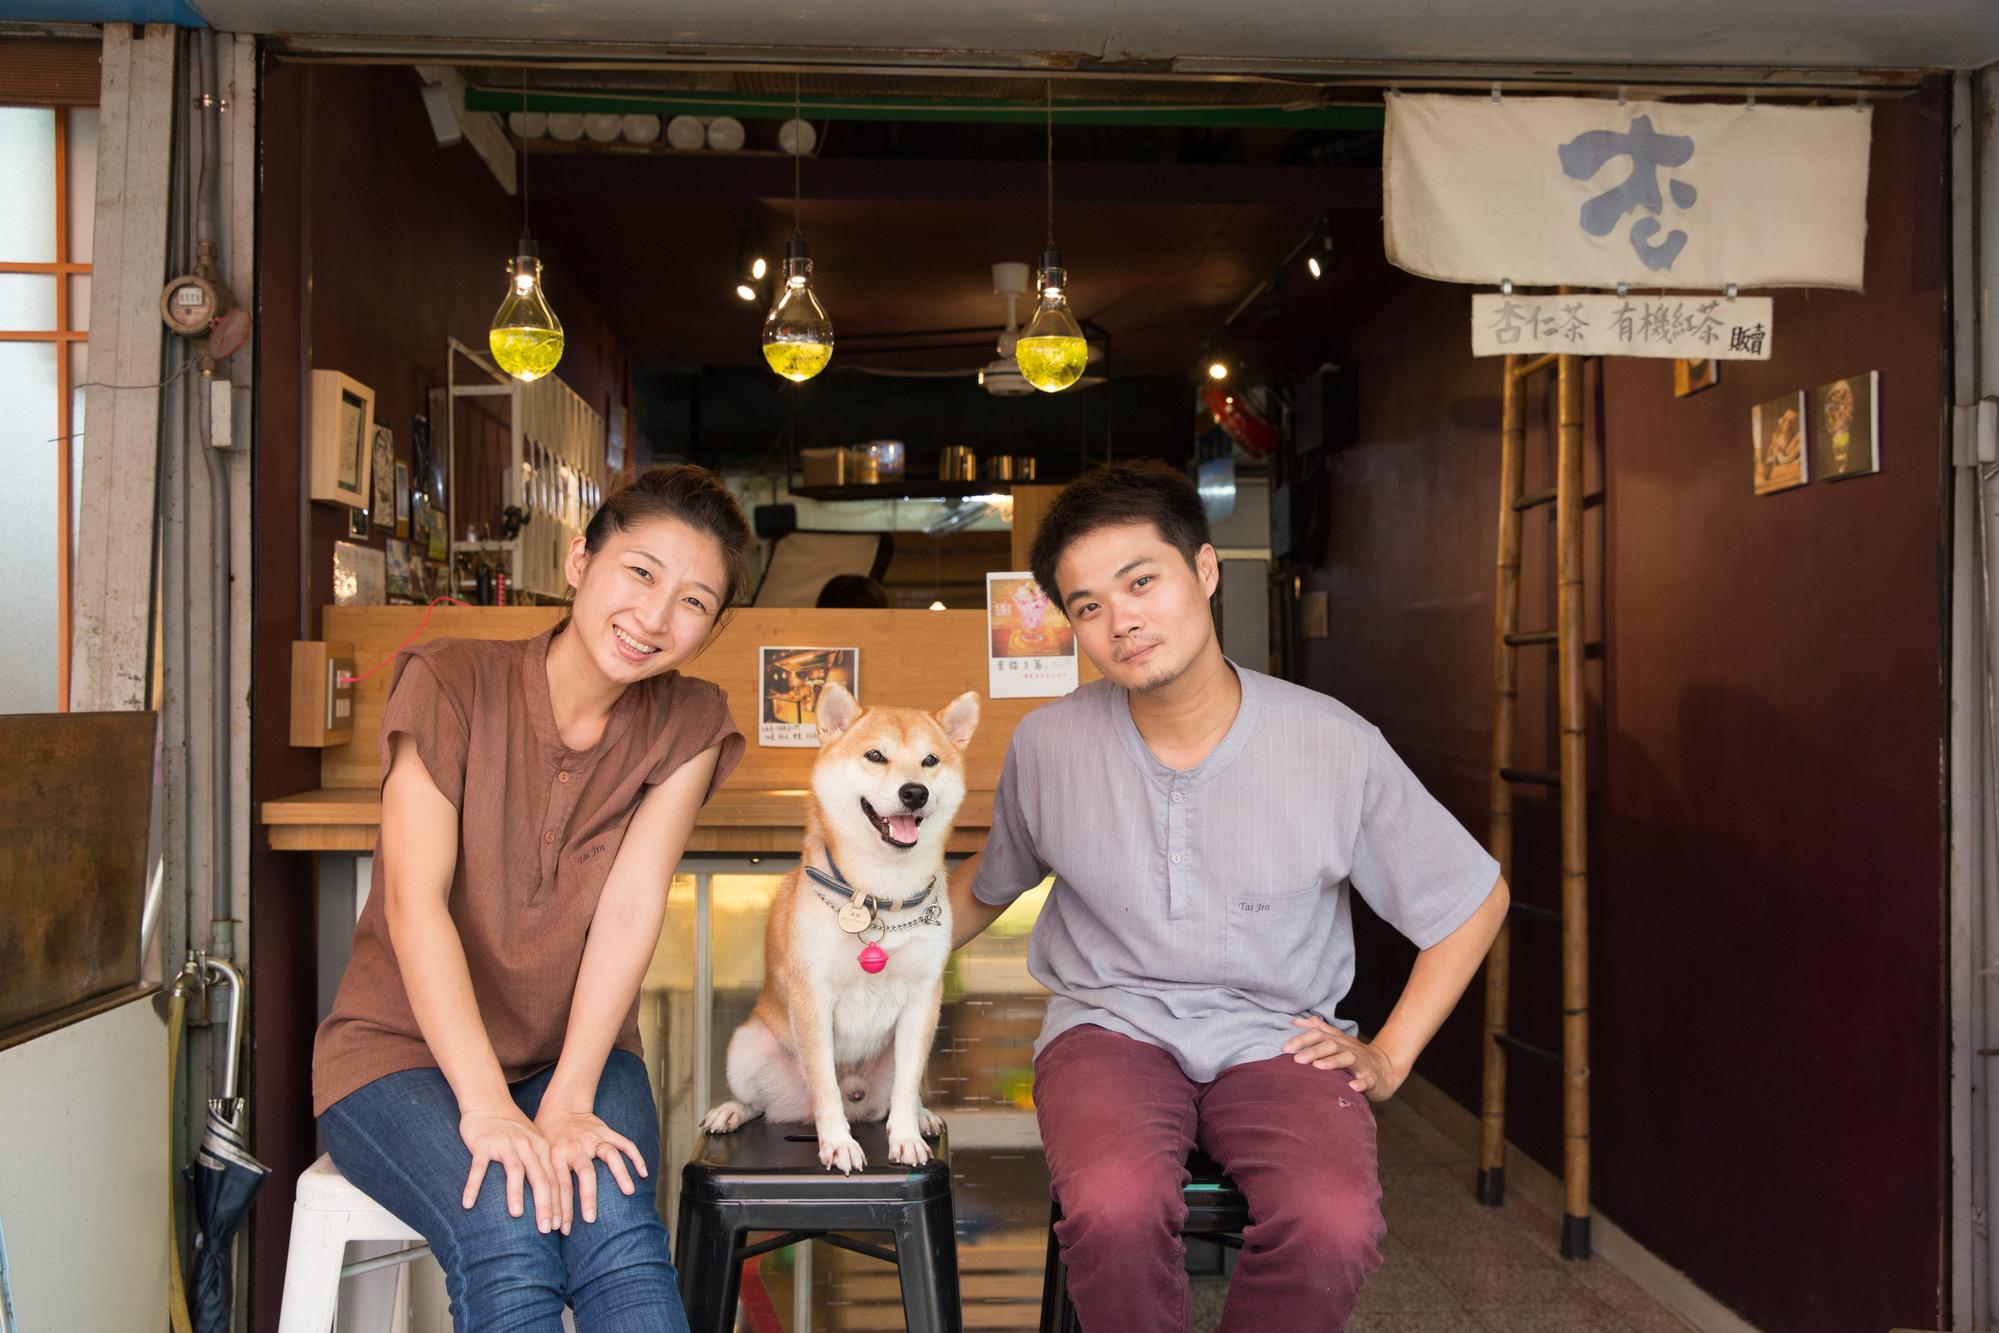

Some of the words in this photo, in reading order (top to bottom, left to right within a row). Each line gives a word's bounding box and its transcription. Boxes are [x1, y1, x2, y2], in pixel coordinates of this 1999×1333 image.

[1488, 300, 1591, 344] 杏仁茶
[1608, 300, 1725, 345] 有機紅茶
[1728, 322, 1766, 356] 販賣
